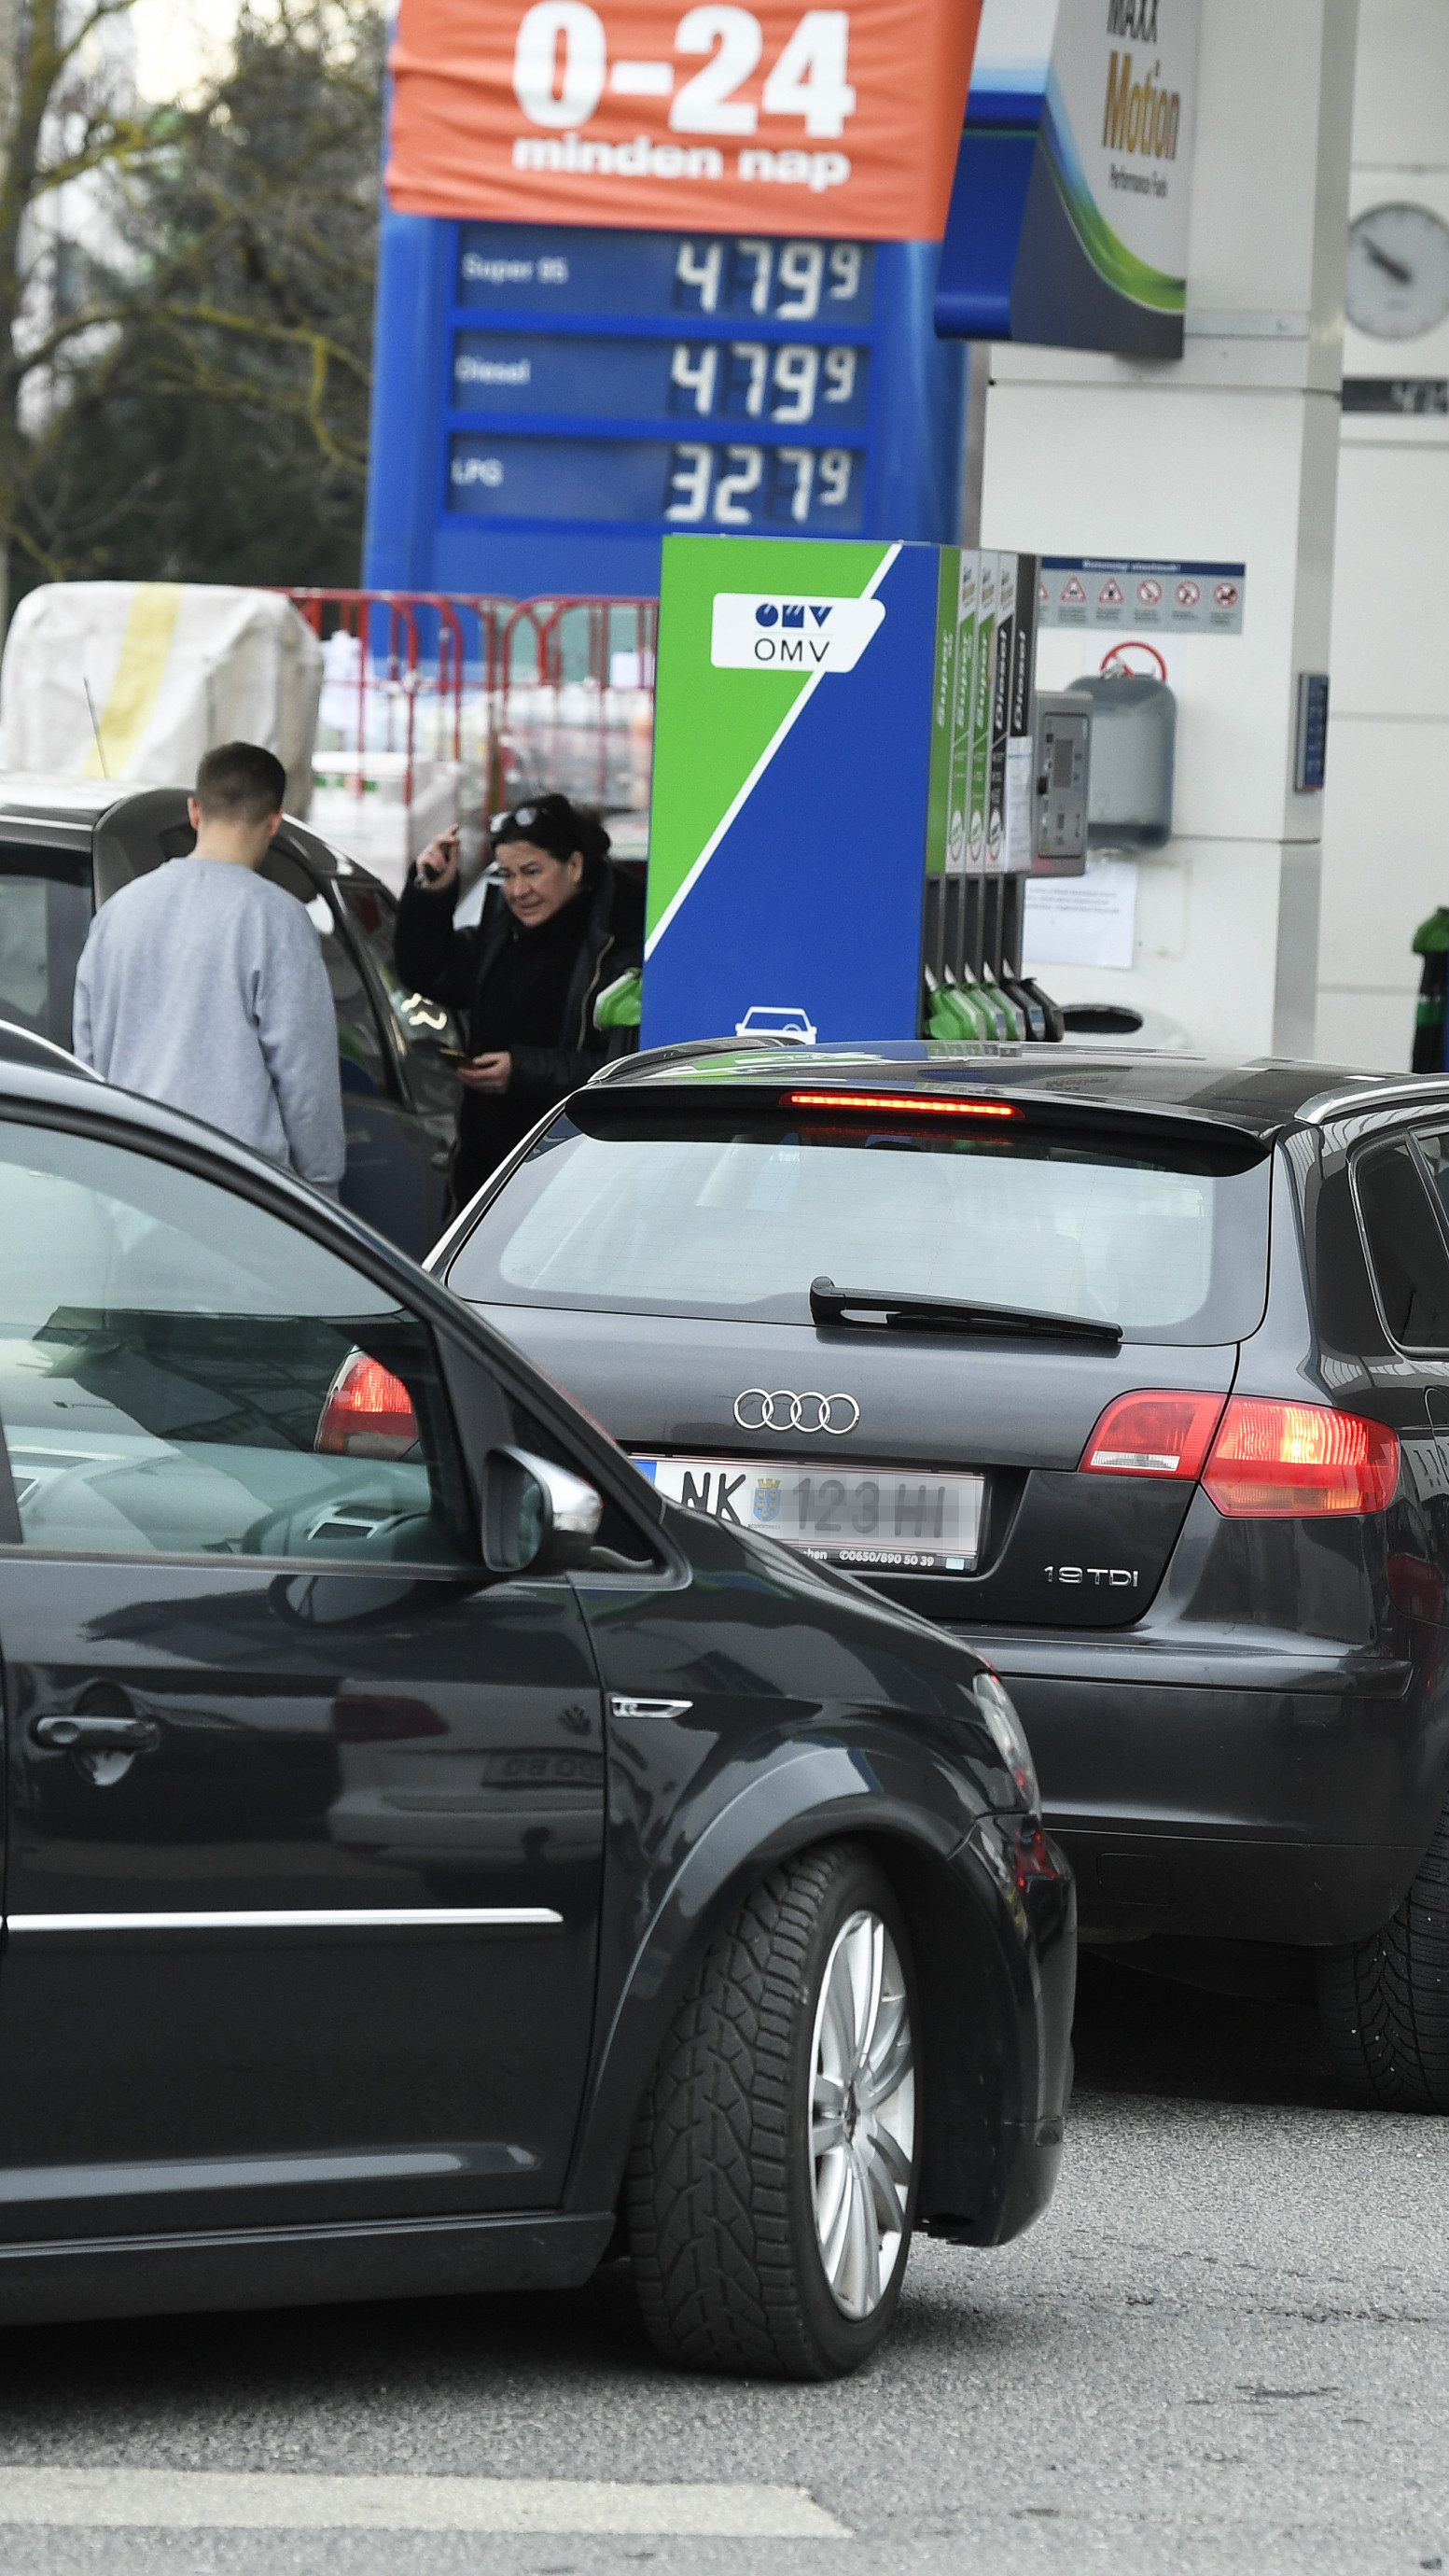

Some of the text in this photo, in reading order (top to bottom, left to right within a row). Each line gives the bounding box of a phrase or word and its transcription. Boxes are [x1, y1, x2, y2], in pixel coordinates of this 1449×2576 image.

[1102, 50, 1179, 160] Motion
[512, 134, 851, 192] minden nap
[462, 252, 533, 286] Super
[454, 355, 531, 385] Diesel
[451, 456, 504, 487] LPG
[754, 637, 830, 663] OMV
[996, 628, 1008, 730] Diesel
[1014, 629, 1026, 731] Diesel
[681, 1471, 745, 1525] NK
[793, 1477, 879, 1533] 123
[903, 1554, 918, 1565] 50
[920, 1556, 934, 1567] 39
